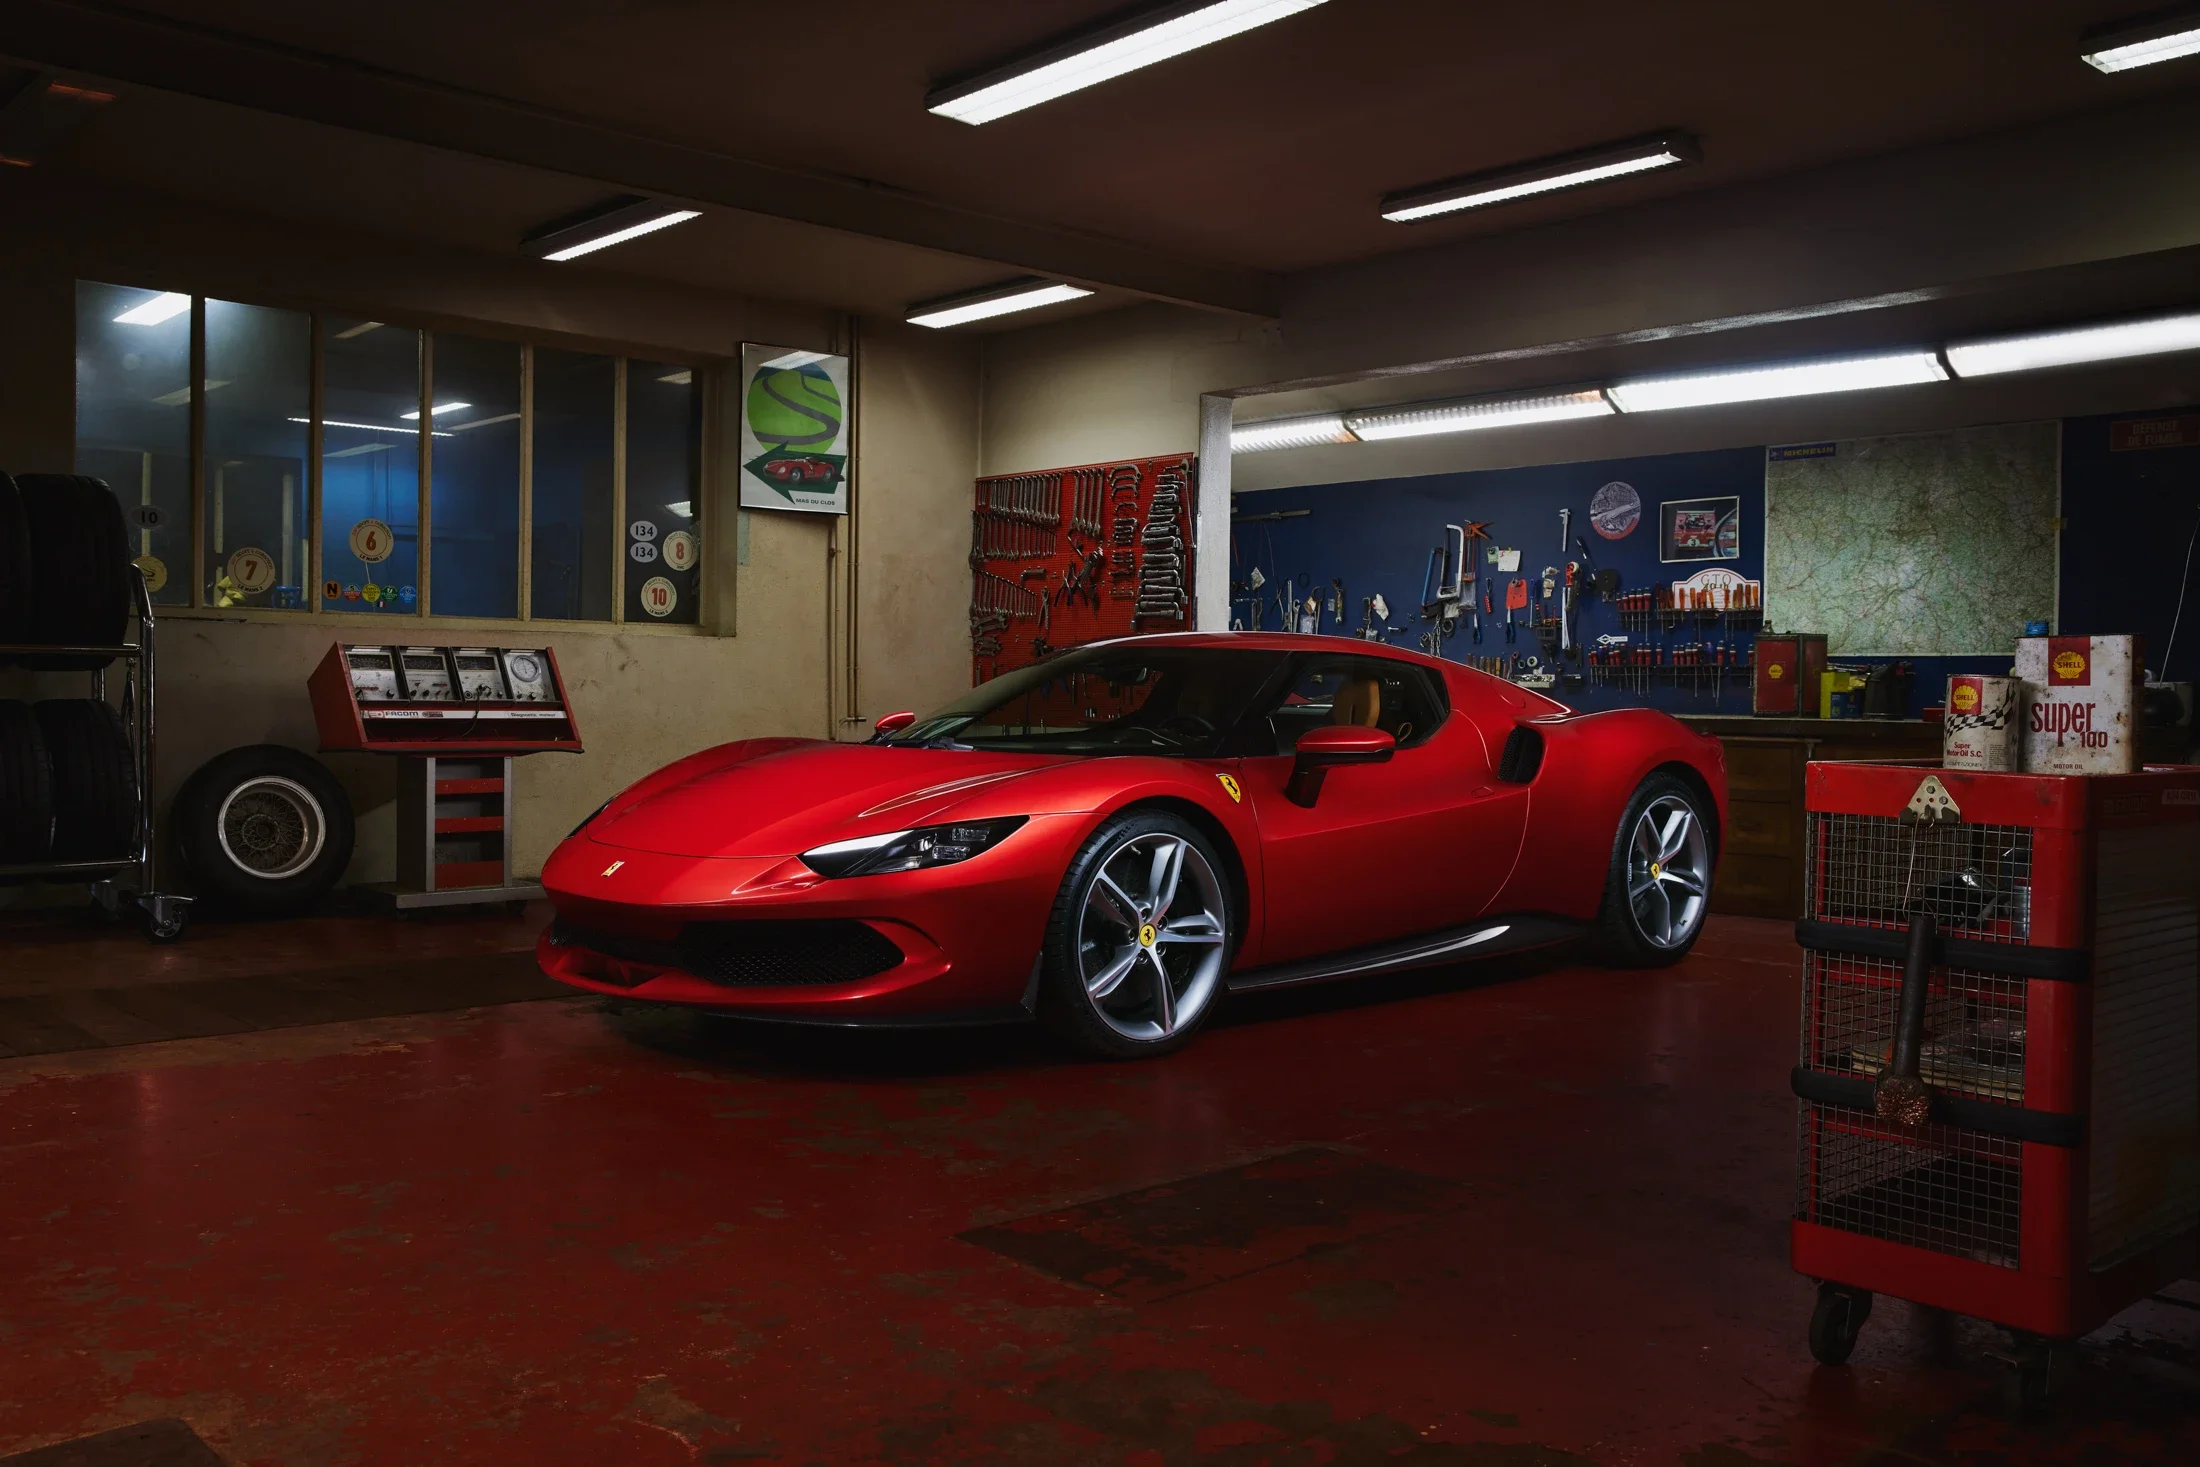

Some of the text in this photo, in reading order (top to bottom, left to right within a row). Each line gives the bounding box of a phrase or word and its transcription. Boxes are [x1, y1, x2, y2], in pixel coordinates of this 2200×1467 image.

[1784, 446, 1833, 457] MICHELIN
[141, 510, 157, 524] 10
[636, 525, 654, 536] 134
[366, 531, 376, 551] 6
[1691, 539, 1696, 547] 3
[636, 547, 654, 558] 134
[676, 542, 684, 560] 8
[246, 560, 257, 581] 7
[1701, 574, 1731, 586] GTO
[327, 583, 338, 594] N
[652, 588, 666, 606] 10
[2058, 661, 2081, 669] SHELL
[2031, 703, 2096, 748] super
[2080, 731, 2108, 748] 100
[1954, 741, 1972, 750] Super
[1947, 749, 1959, 757] Motor
[1970, 750, 1983, 758] S.C.
